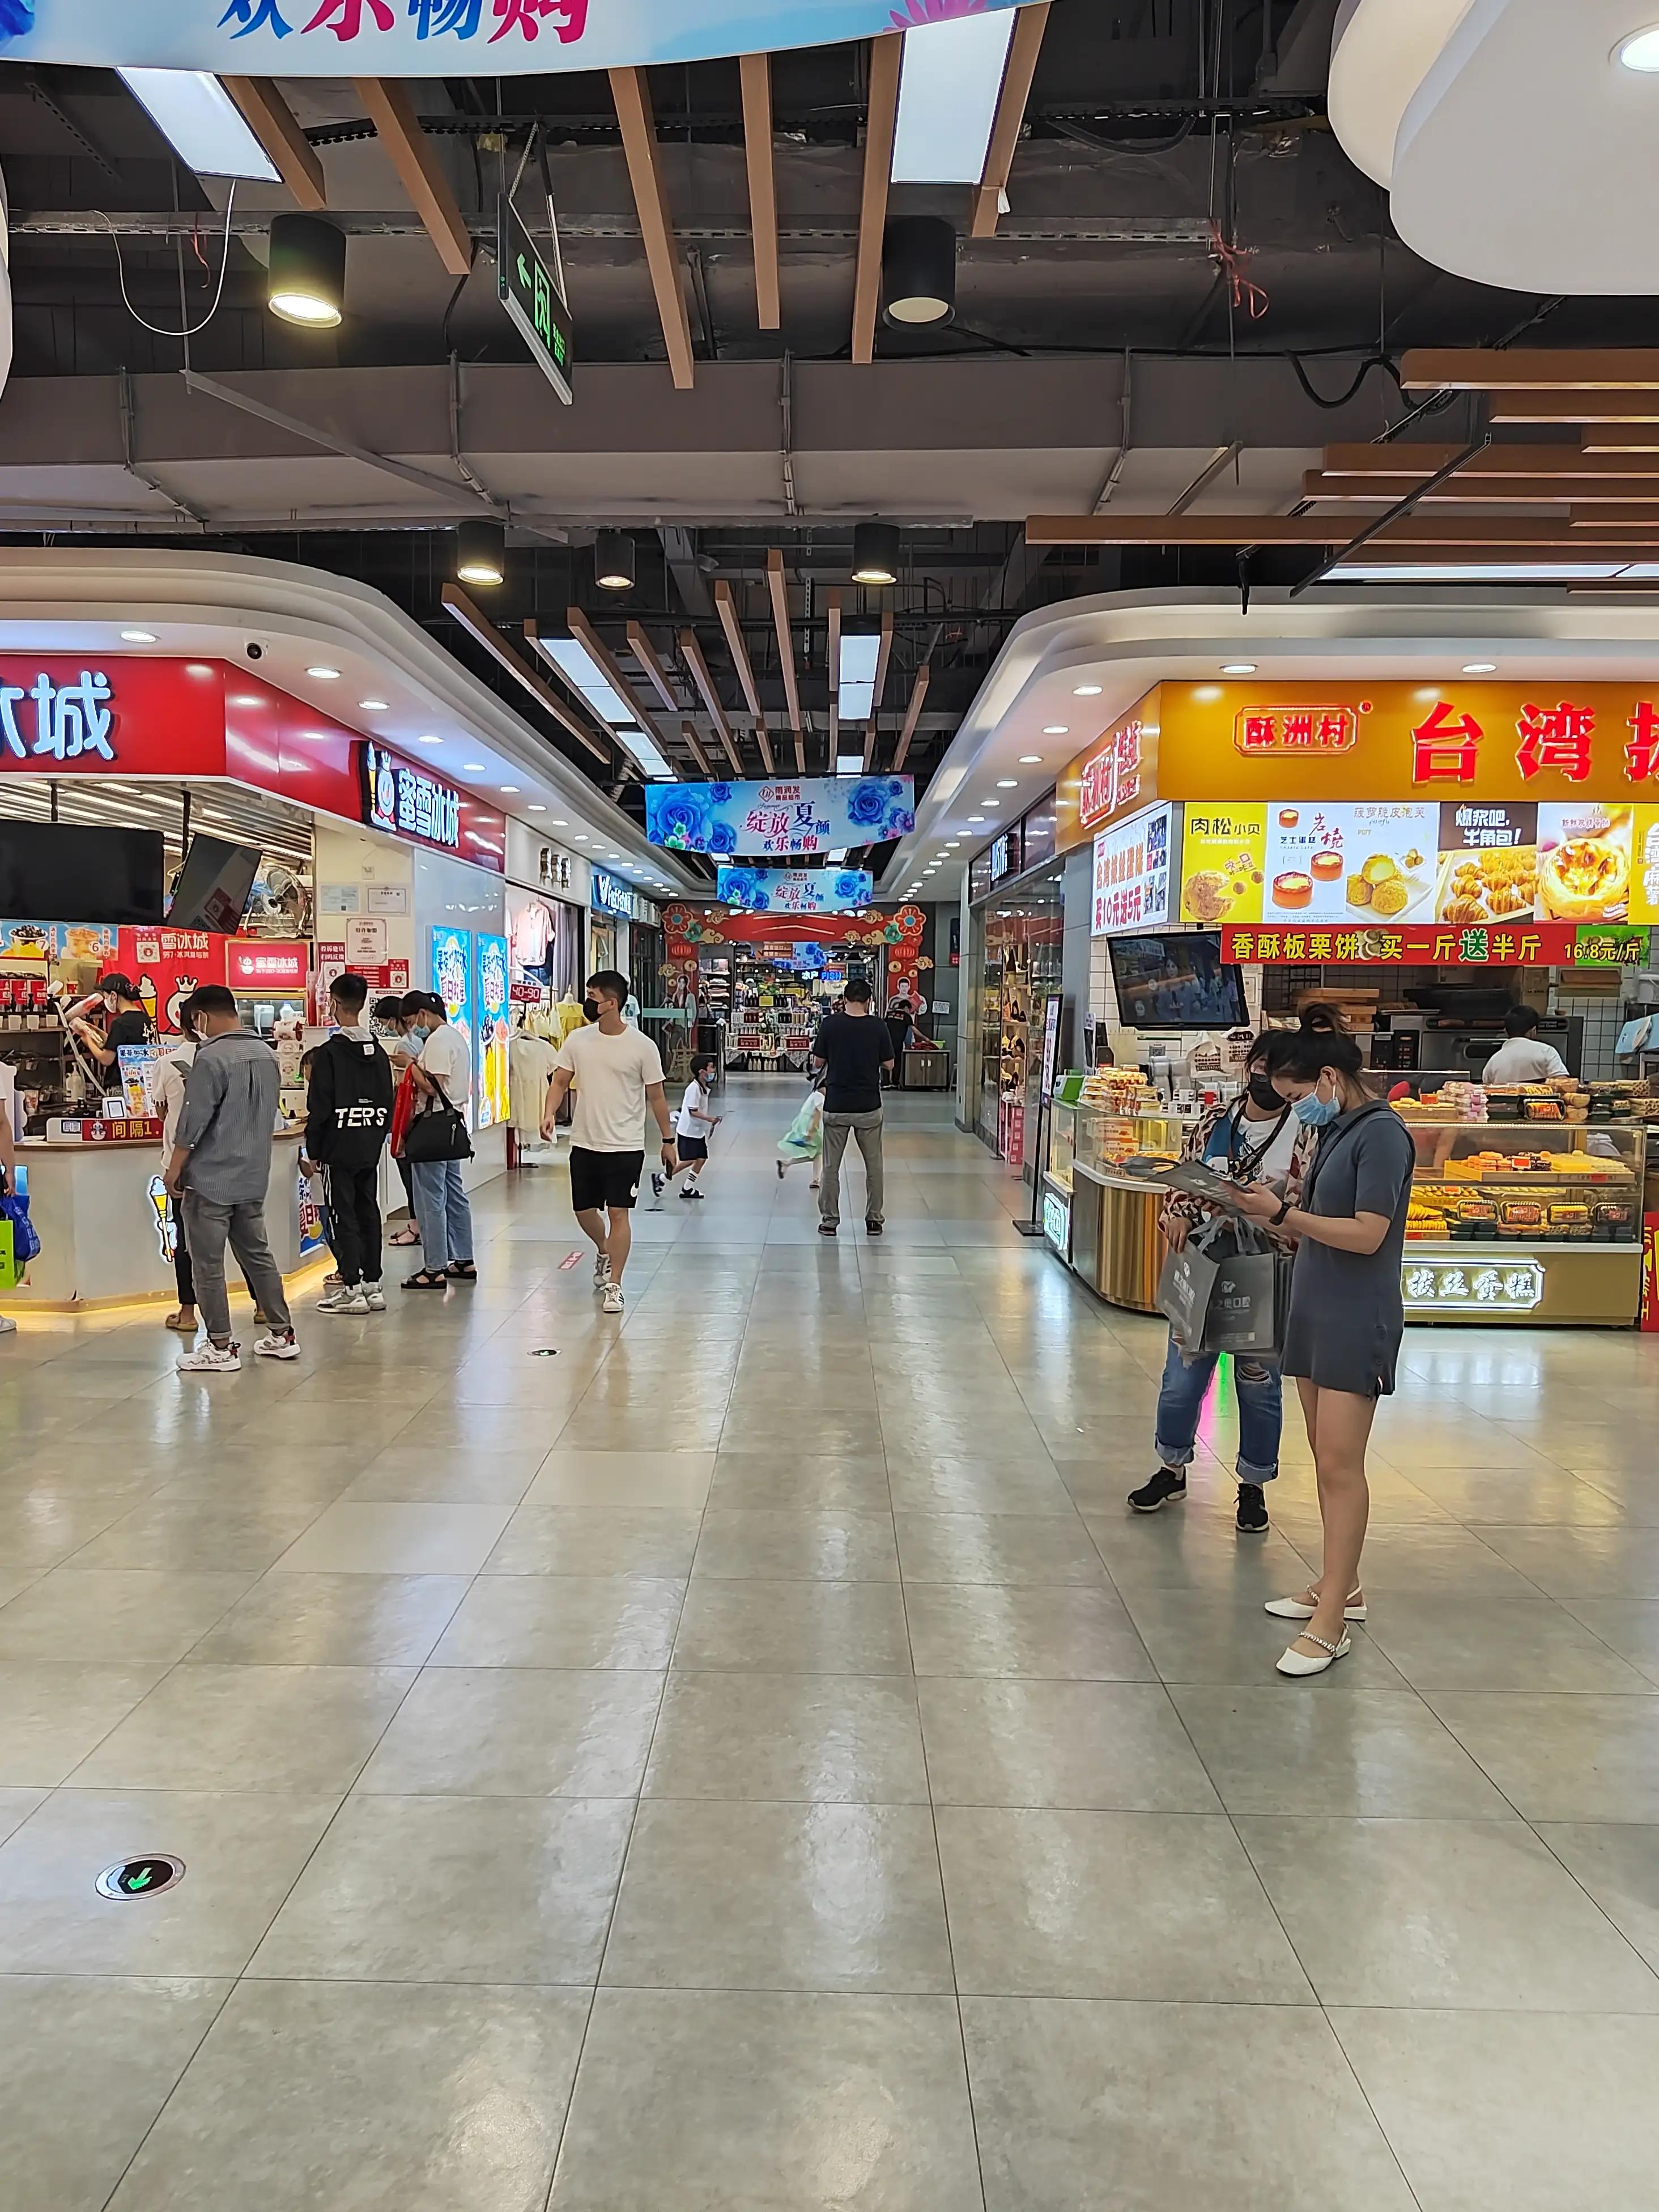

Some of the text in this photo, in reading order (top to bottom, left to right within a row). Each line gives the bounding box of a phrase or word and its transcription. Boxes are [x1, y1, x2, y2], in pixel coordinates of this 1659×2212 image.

[1244, 714, 1349, 747] 酥洲村
[398, 768, 459, 848] 蜜雪冰城
[1191, 818, 1260, 835] 肉松小贝
[763, 835, 818, 851] 欢乐畅购
[1231, 929, 1640, 962] 香酥板栗饼 买一斤送半斤 16.8元/斤
[335, 1107, 388, 1128] TERS
